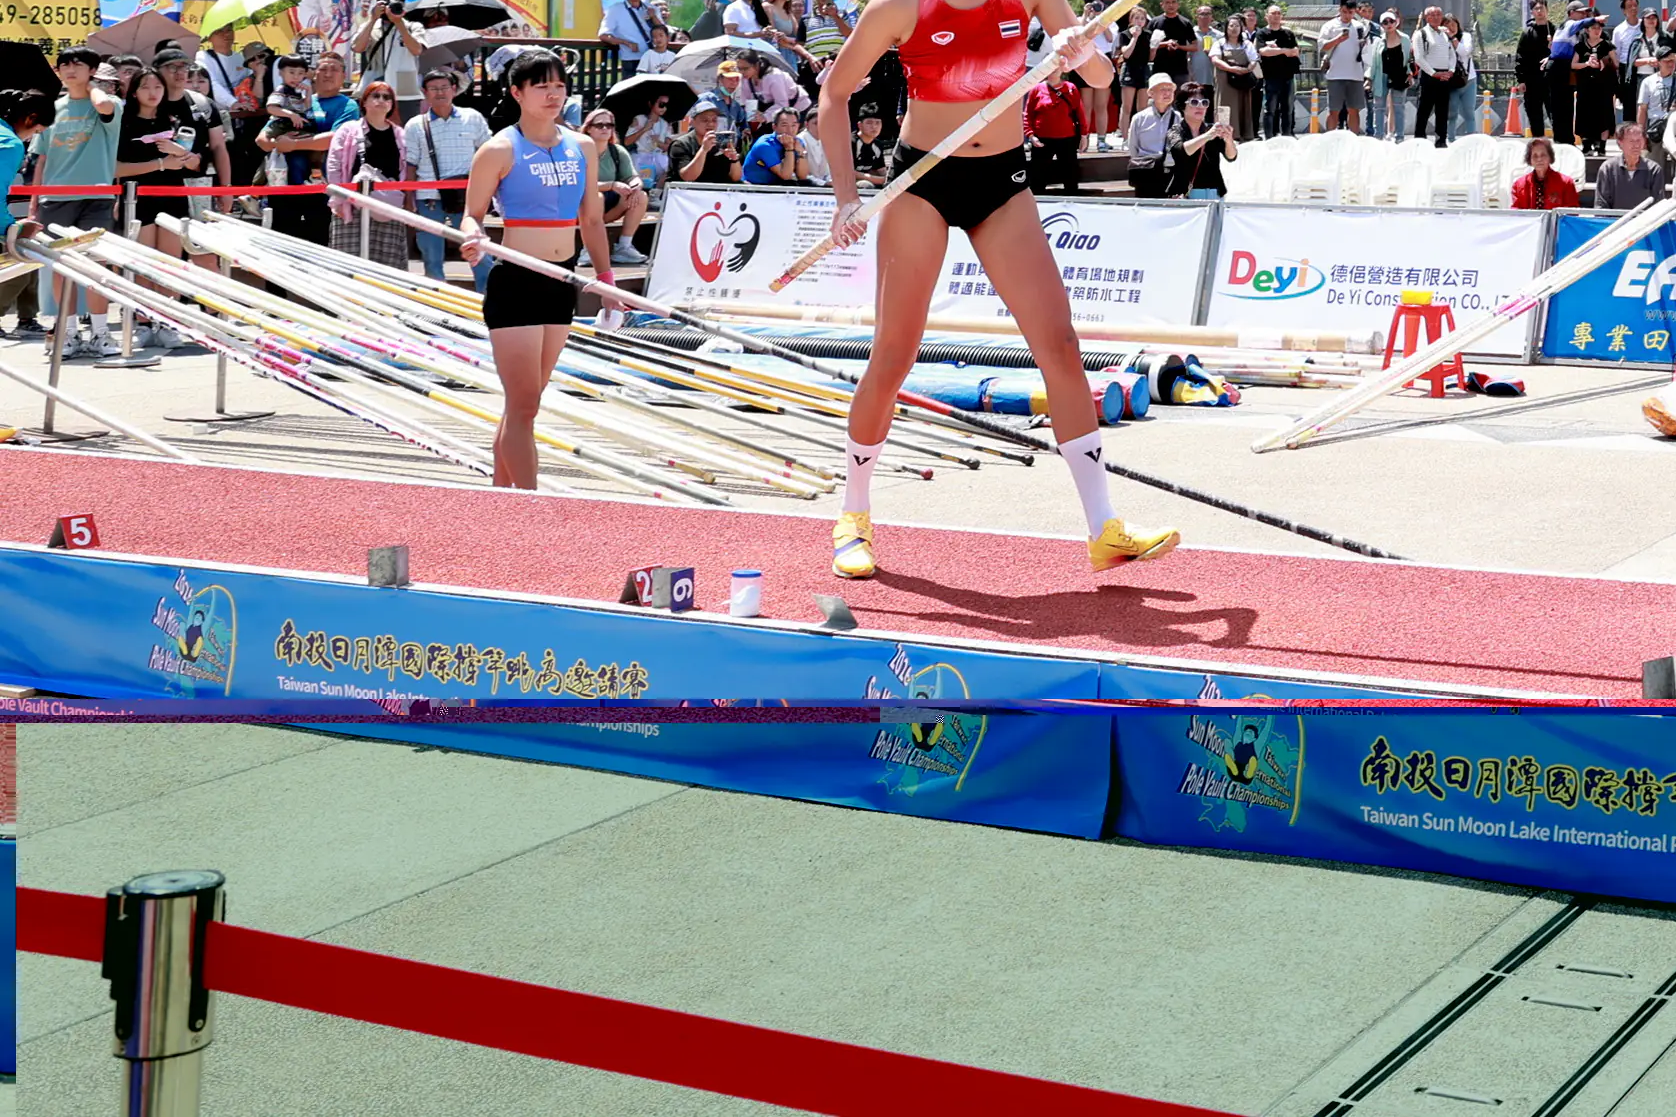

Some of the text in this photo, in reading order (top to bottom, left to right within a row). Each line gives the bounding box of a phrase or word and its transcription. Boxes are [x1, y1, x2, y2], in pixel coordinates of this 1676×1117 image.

[529, 160, 581, 176] CHINESE
[539, 172, 578, 187] TAIPEI
[1056, 230, 1101, 250] Qiao
[1228, 250, 1310, 294] Deyi
[1327, 289, 1345, 305] De
[1349, 290, 1361, 305] Yi
[70, 517, 92, 547] 5
[636, 571, 653, 602] 2
[277, 676, 319, 694] Taiwan
[320, 681, 343, 697] Sun
[1360, 806, 1419, 828] Taiwan
[1422, 812, 1455, 832] Sun
[1458, 816, 1506, 837] Moon
[1509, 819, 1550, 841] Lake
[1553, 825, 1667, 853] International
